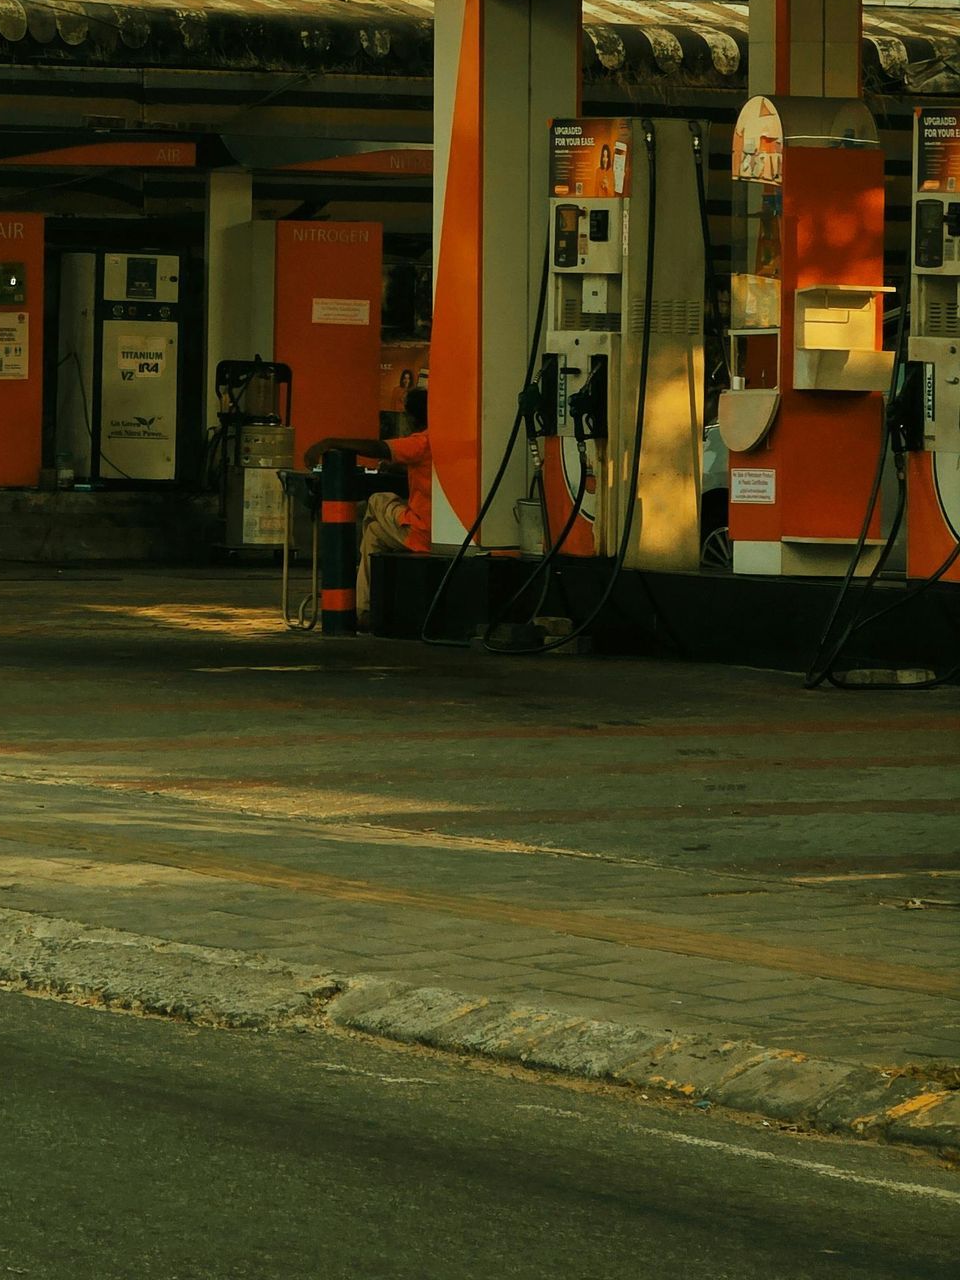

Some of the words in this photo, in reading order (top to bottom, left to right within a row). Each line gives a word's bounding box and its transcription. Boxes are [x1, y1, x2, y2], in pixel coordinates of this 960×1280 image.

[156, 148, 181, 161] AIR
[293, 228, 369, 242] NITROGEN
[121, 351, 163, 360] TITANIUM
